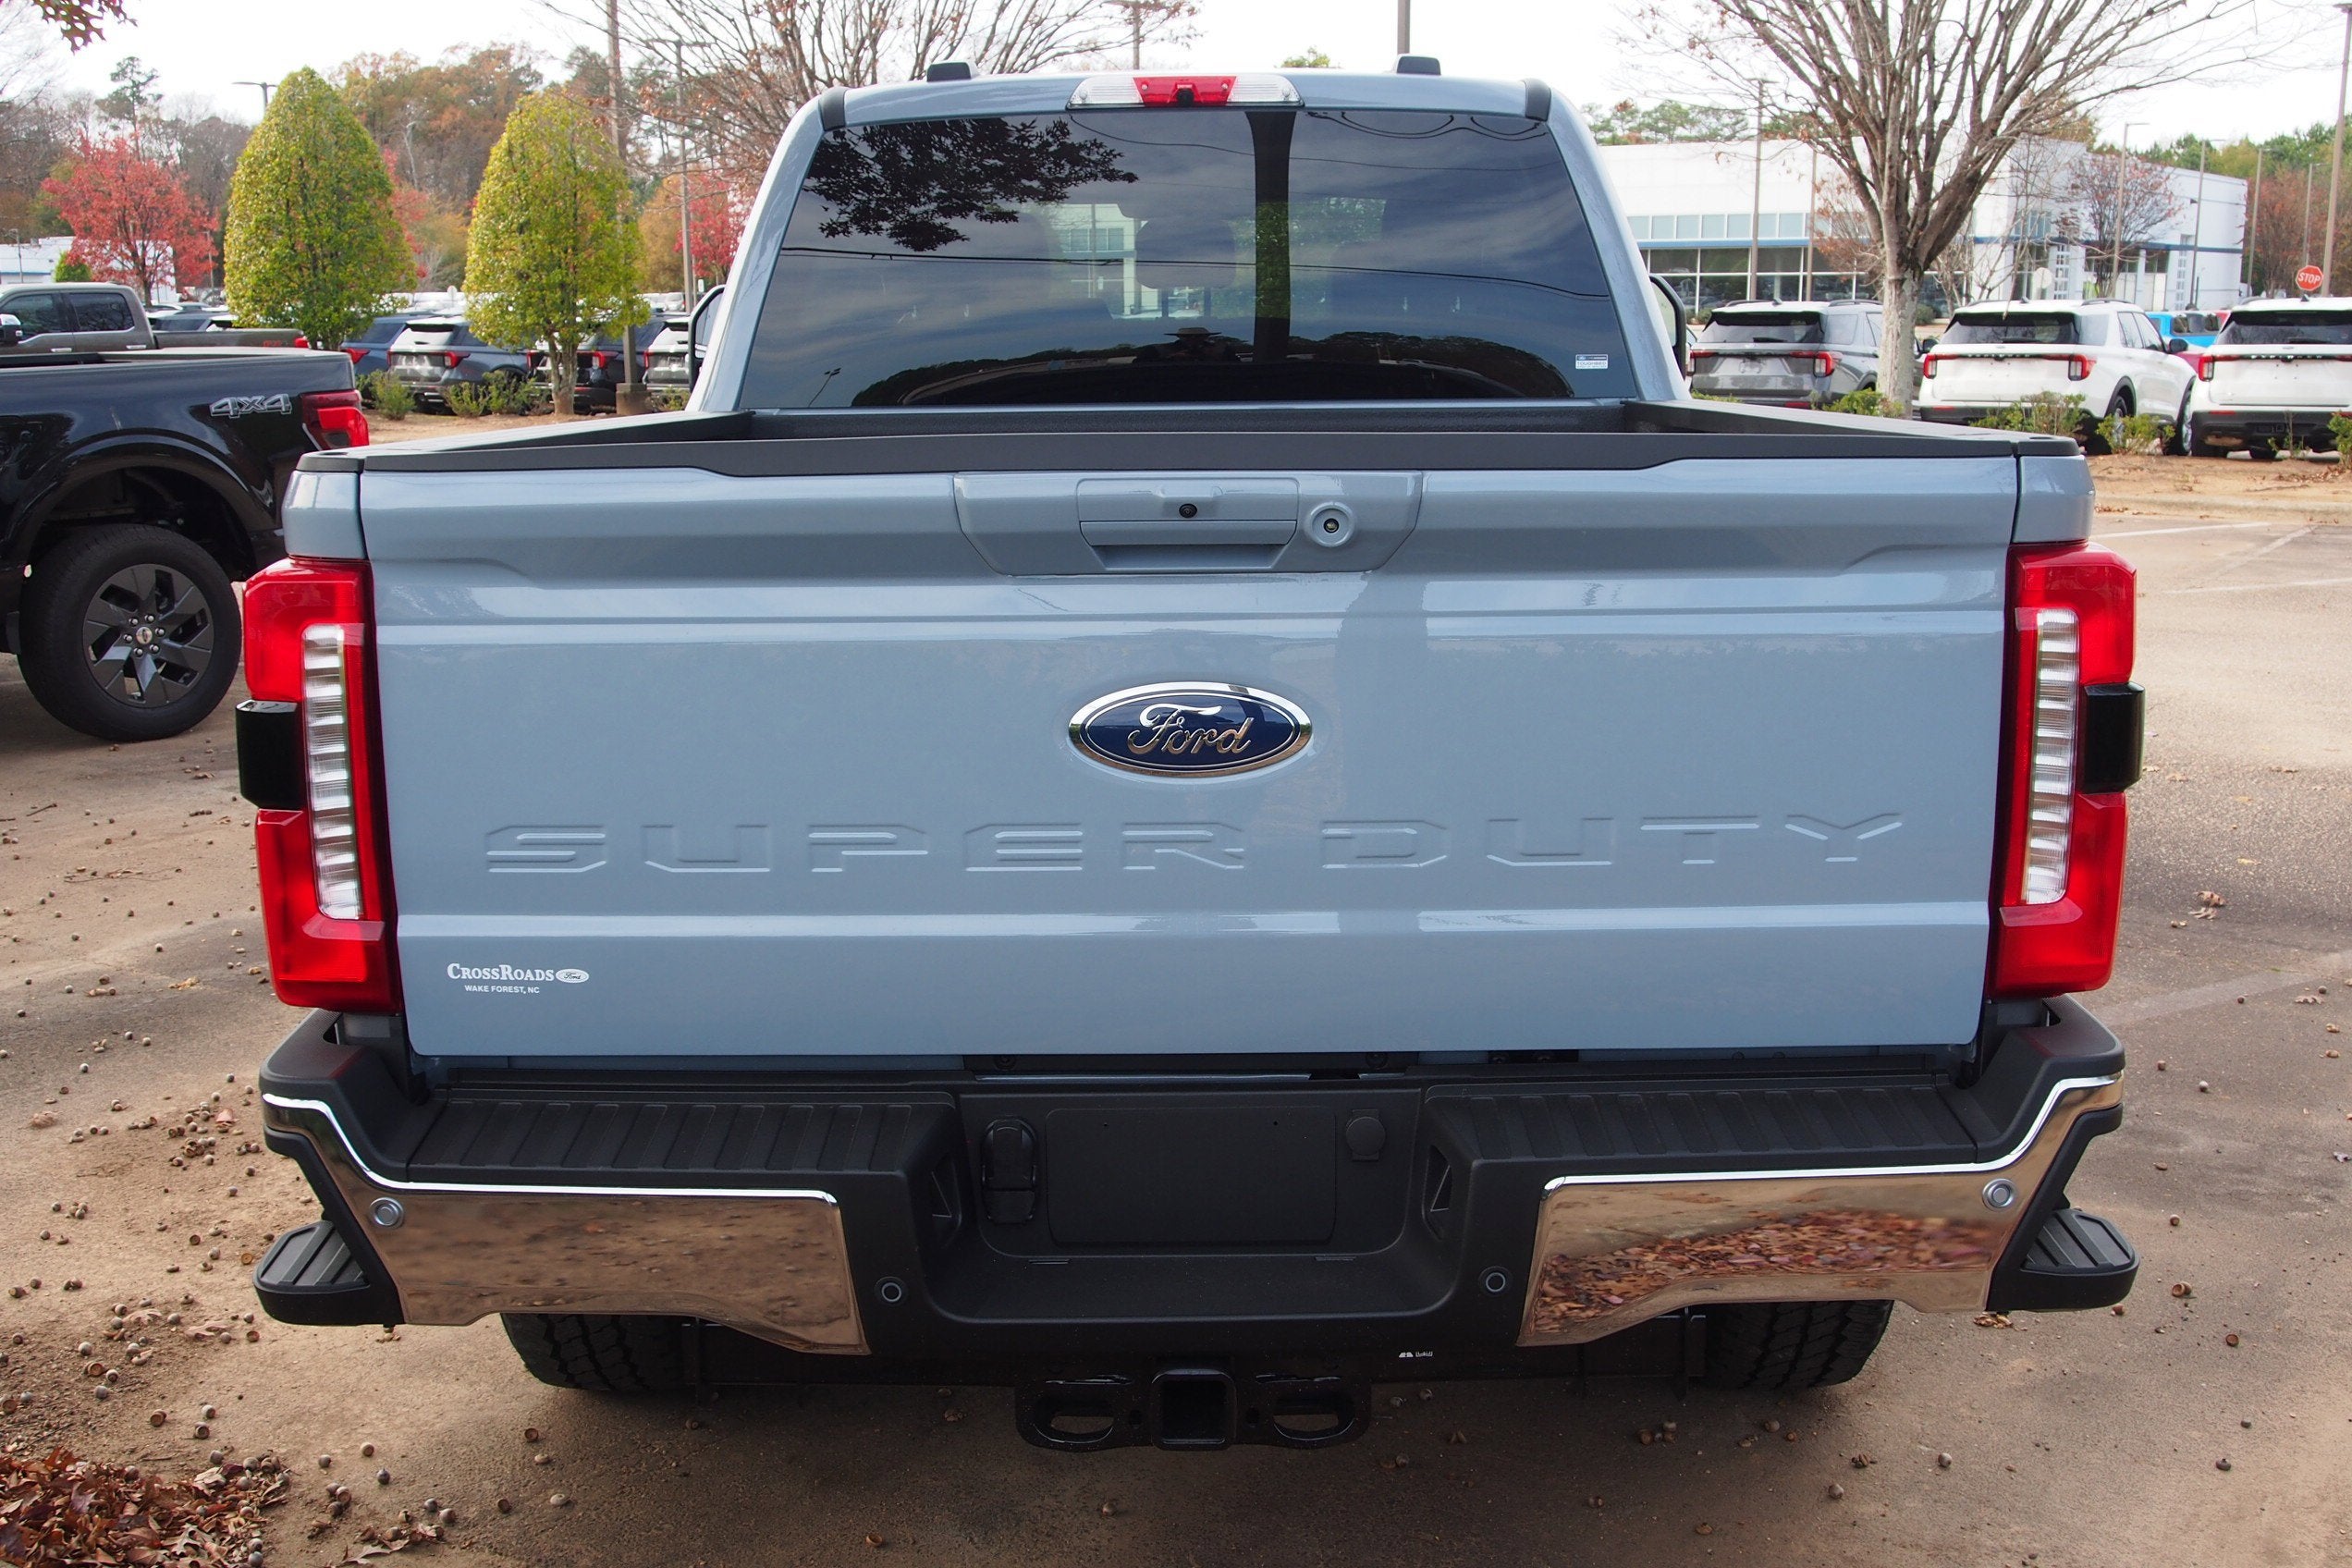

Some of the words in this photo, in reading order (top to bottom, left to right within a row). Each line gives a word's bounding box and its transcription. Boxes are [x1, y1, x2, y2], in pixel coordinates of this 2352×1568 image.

[2297, 272, 2321, 285] STOP
[1127, 703, 1255, 755] Ford
[485, 822, 1245, 873] SUPER
[1320, 813, 1903, 871] DUTY
[464, 985, 490, 993] WAKE
[491, 986, 527, 995] FOREST,
